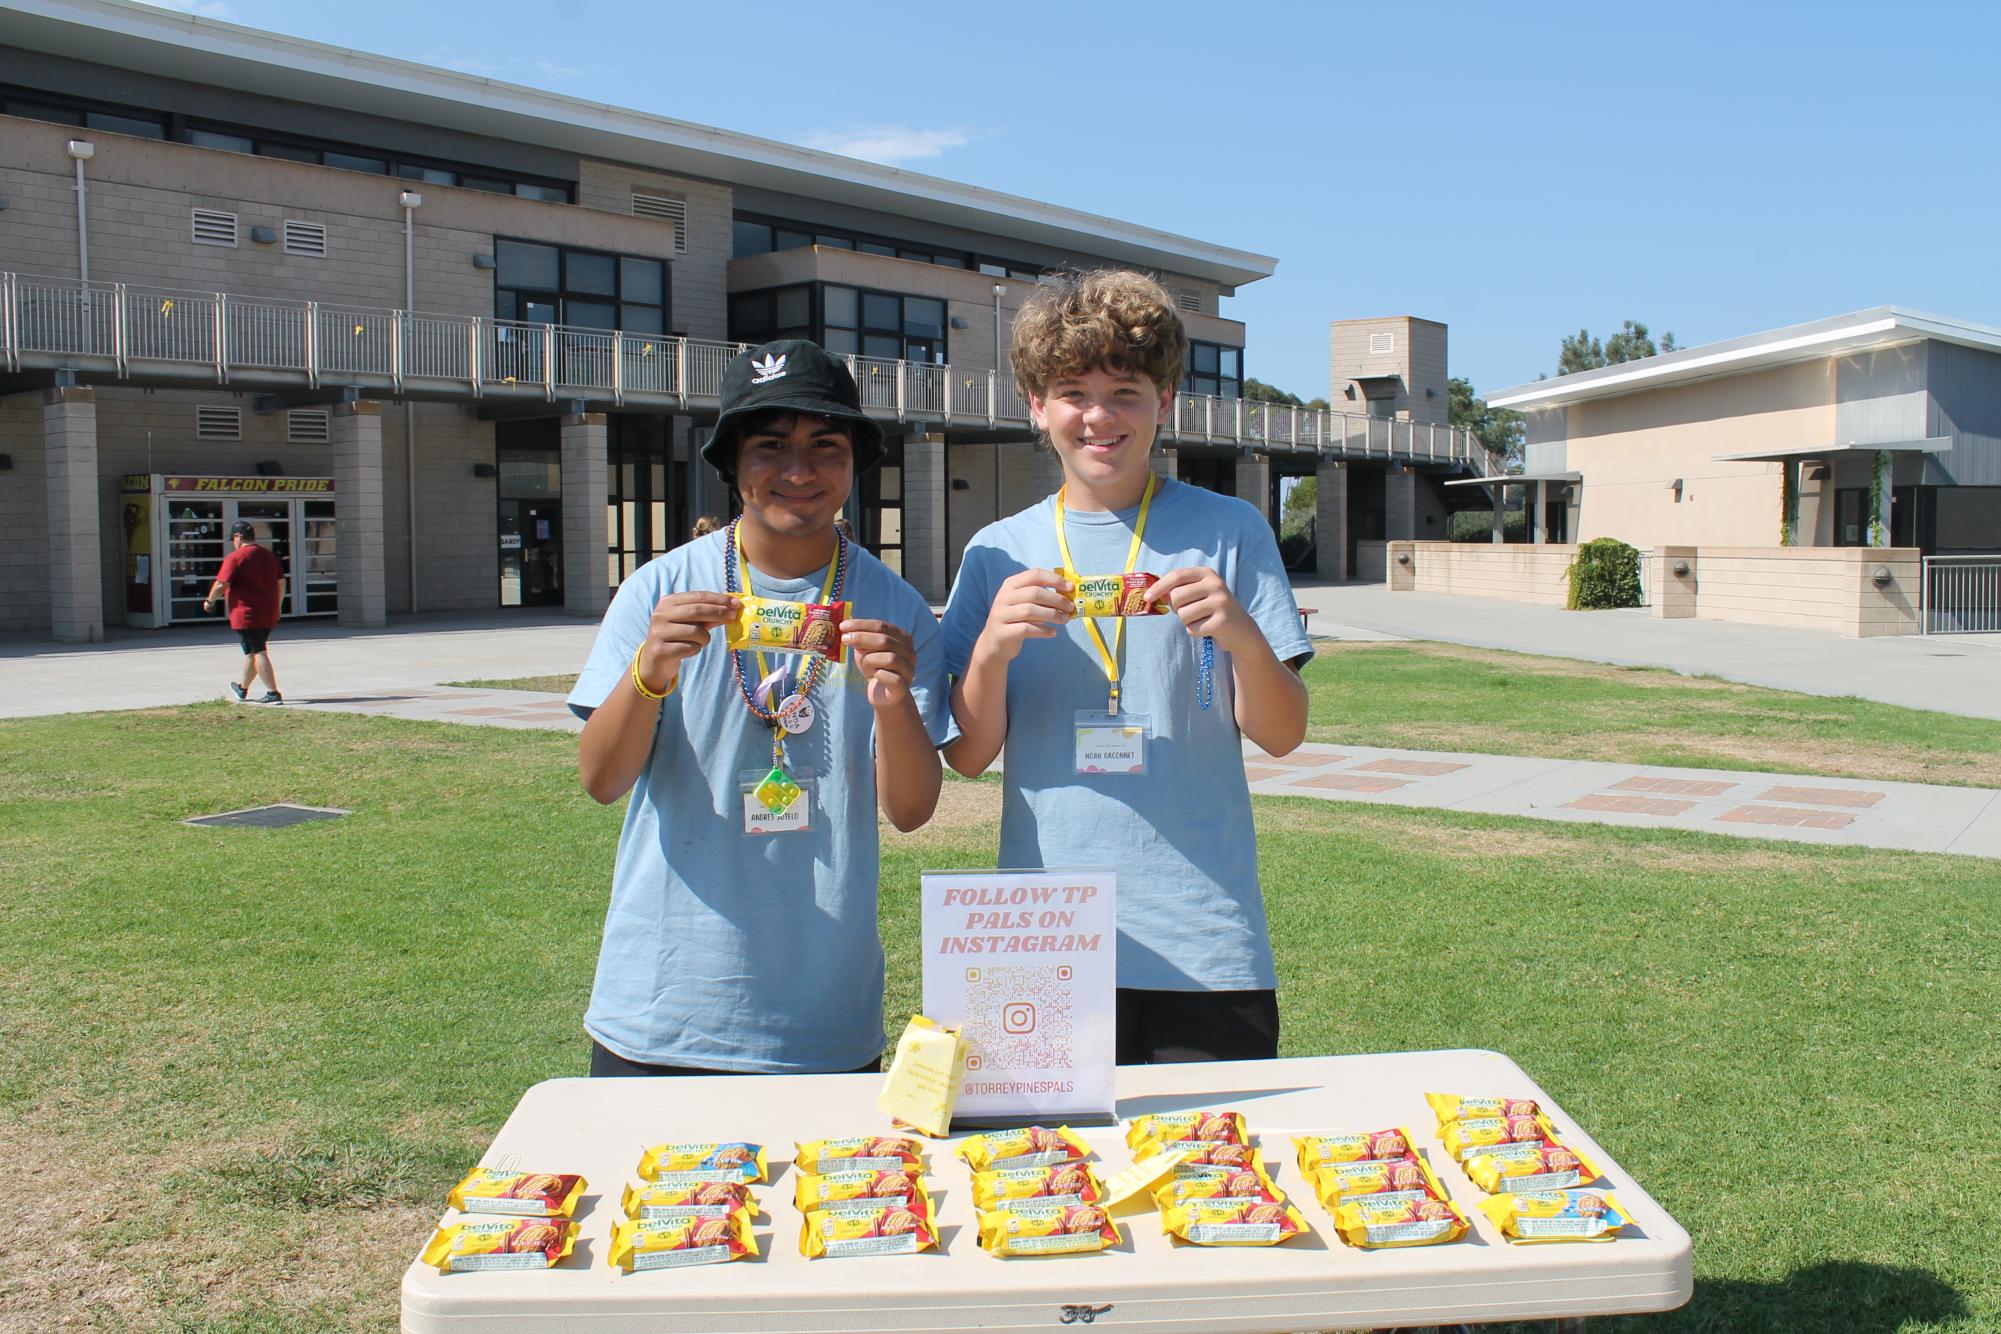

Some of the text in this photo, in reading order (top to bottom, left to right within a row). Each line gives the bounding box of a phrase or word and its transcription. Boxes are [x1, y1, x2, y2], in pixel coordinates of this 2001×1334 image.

[752, 371, 786, 384] adidas
[195, 478, 330, 491] FALCON PRIDE
[1079, 578, 1120, 592] belVita
[756, 604, 802, 620] belVita
[762, 617, 794, 625] CRUNCHY
[1085, 752, 1102, 760] NOAH
[751, 813, 775, 822] ANDRES
[943, 886, 1098, 906] FOLLOW TP
[965, 910, 1076, 930] PALS ON
[939, 934, 1102, 954] INSTAGRAM
[965, 1081, 1074, 1096] @TORREYPINESPALS
[637, 1217, 691, 1230] belVita
